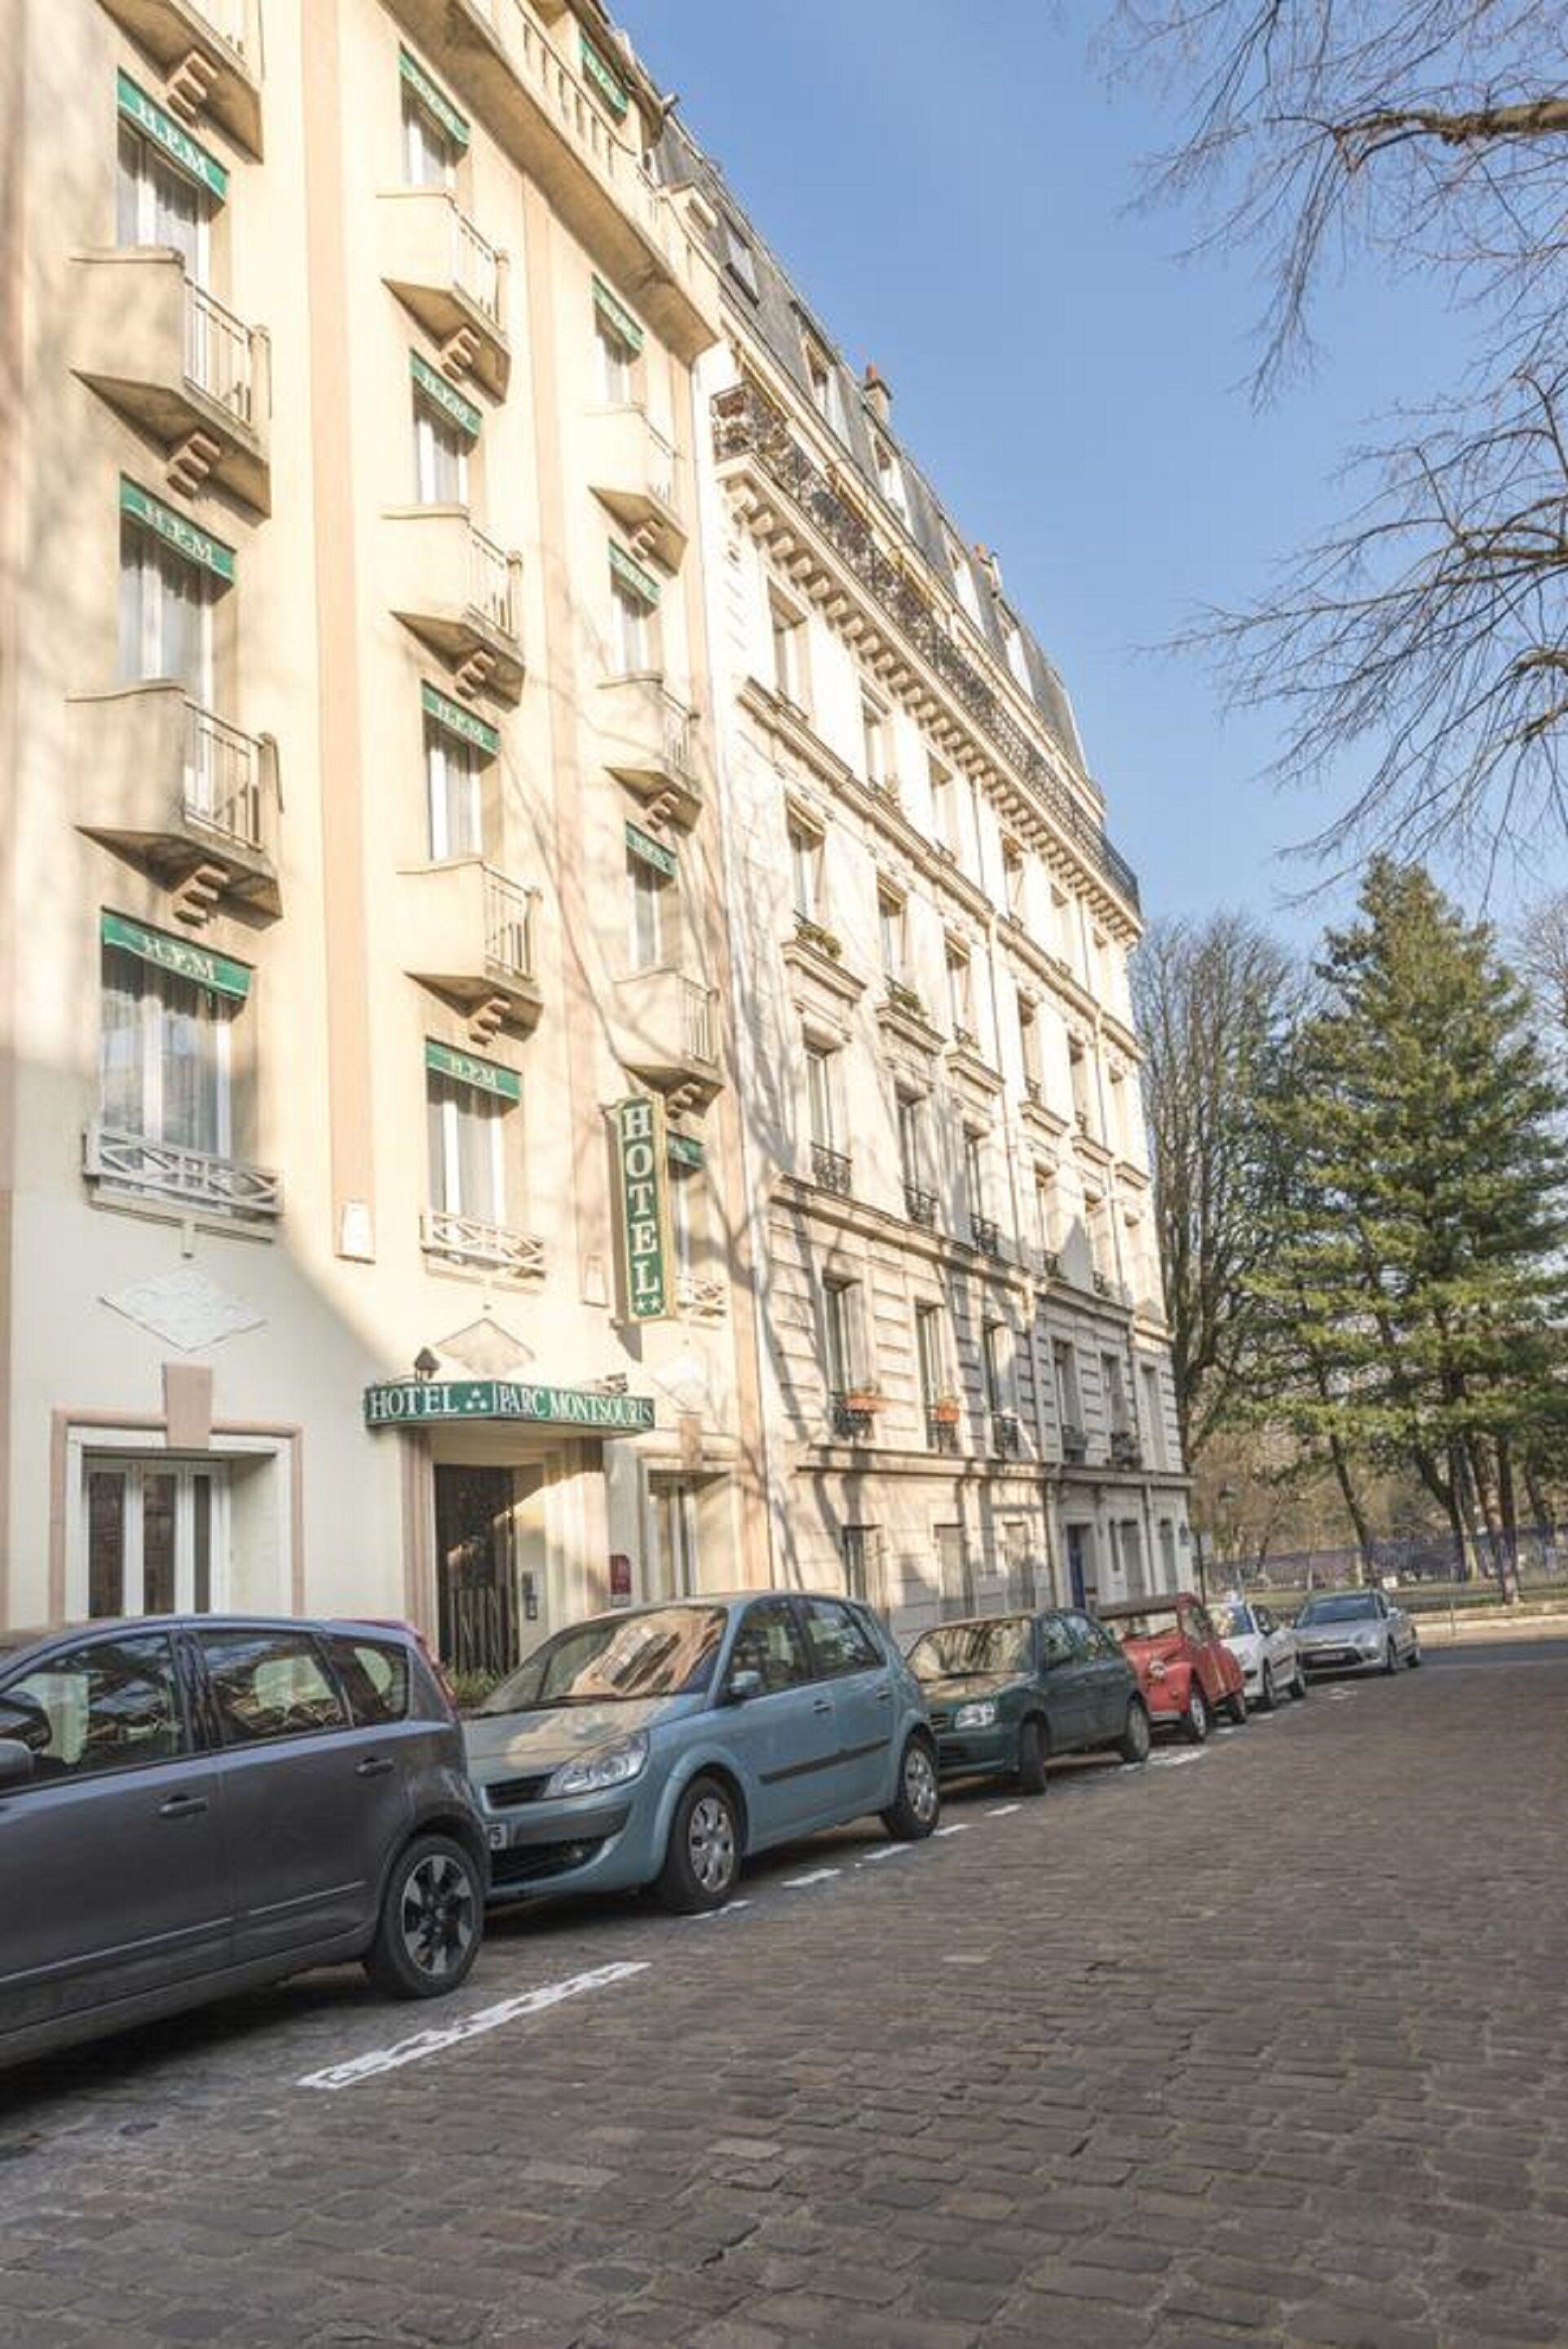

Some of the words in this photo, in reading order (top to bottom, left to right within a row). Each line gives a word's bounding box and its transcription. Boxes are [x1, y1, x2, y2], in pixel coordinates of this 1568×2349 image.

[623, 1104, 660, 1295] HOTEL
[370, 1386, 458, 1419] HOTEL
[500, 1385, 545, 1415] PARC
[550, 1389, 653, 1424] MONTSOURIS
